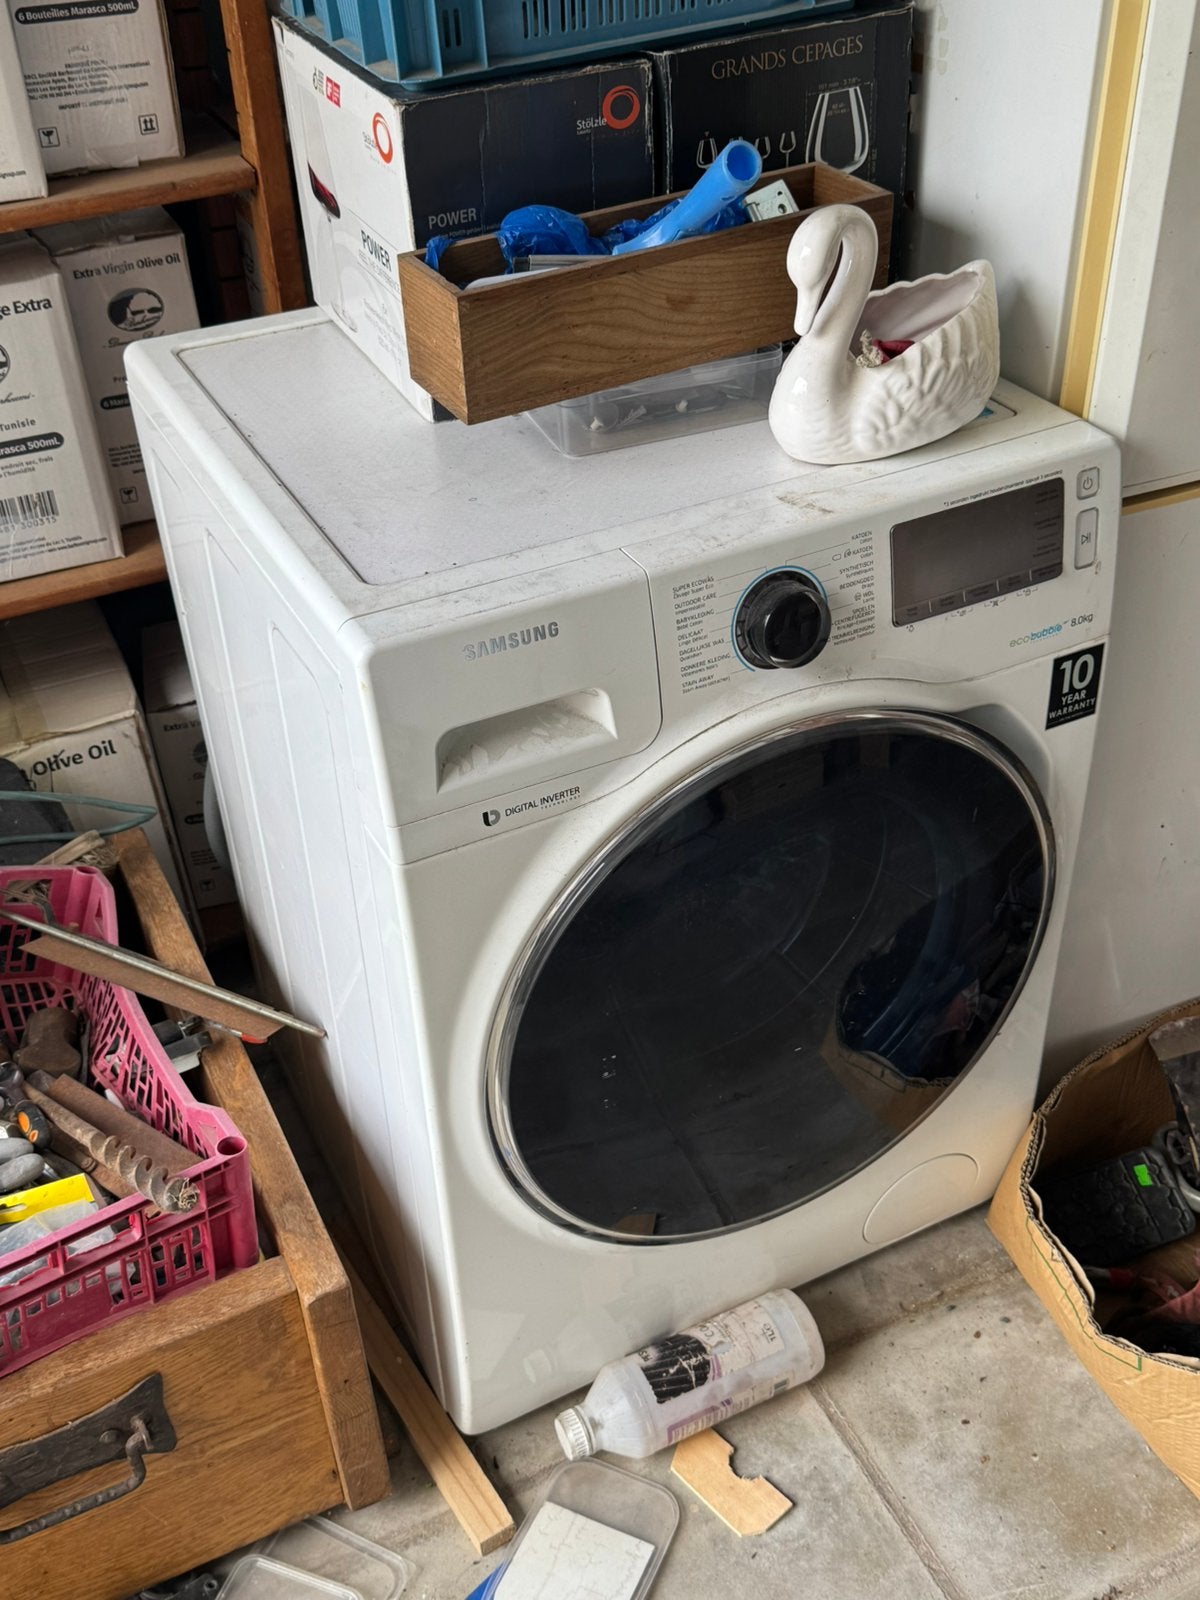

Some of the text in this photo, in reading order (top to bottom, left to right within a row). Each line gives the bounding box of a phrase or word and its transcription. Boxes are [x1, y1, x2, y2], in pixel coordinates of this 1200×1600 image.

[18, 13, 25, 22] 6
[71, 6, 107, 17] Marasca
[107, 2, 137, 13] 500mL
[711, 34, 864, 80] GRANDS CEPAGES
[576, 115, 608, 131] Stölzle
[428, 207, 477, 230] POWER
[360, 229, 392, 272] POWER
[73, 253, 182, 281] Extra Virgin Olive Oil
[13, 296, 53, 316] Extra
[0, 436, 61, 456] rasca 500mL
[851, 530, 873, 541] KATOEN
[852, 544, 873, 555] KATOEN
[672, 583, 691, 594] SUPER
[674, 592, 718, 610] OUTDOOR CARE
[676, 608, 715, 625] BABYKLEDING
[1070, 613, 1094, 629] 8.0kg
[463, 621, 560, 662] SAMSUNG
[677, 628, 704, 642] DELICAAT
[712, 637, 725, 646] WAS
[680, 652, 731, 673] DONKERE KLEDING
[681, 674, 715, 689] STAIN AWAY
[1059, 653, 1095, 695] 10
[1061, 689, 1087, 706] YEAR
[1048, 697, 1097, 719] WARRANTY
[33, 739, 118, 777] Olive Oil
[505, 786, 581, 818] DIGITAL INVERTER
